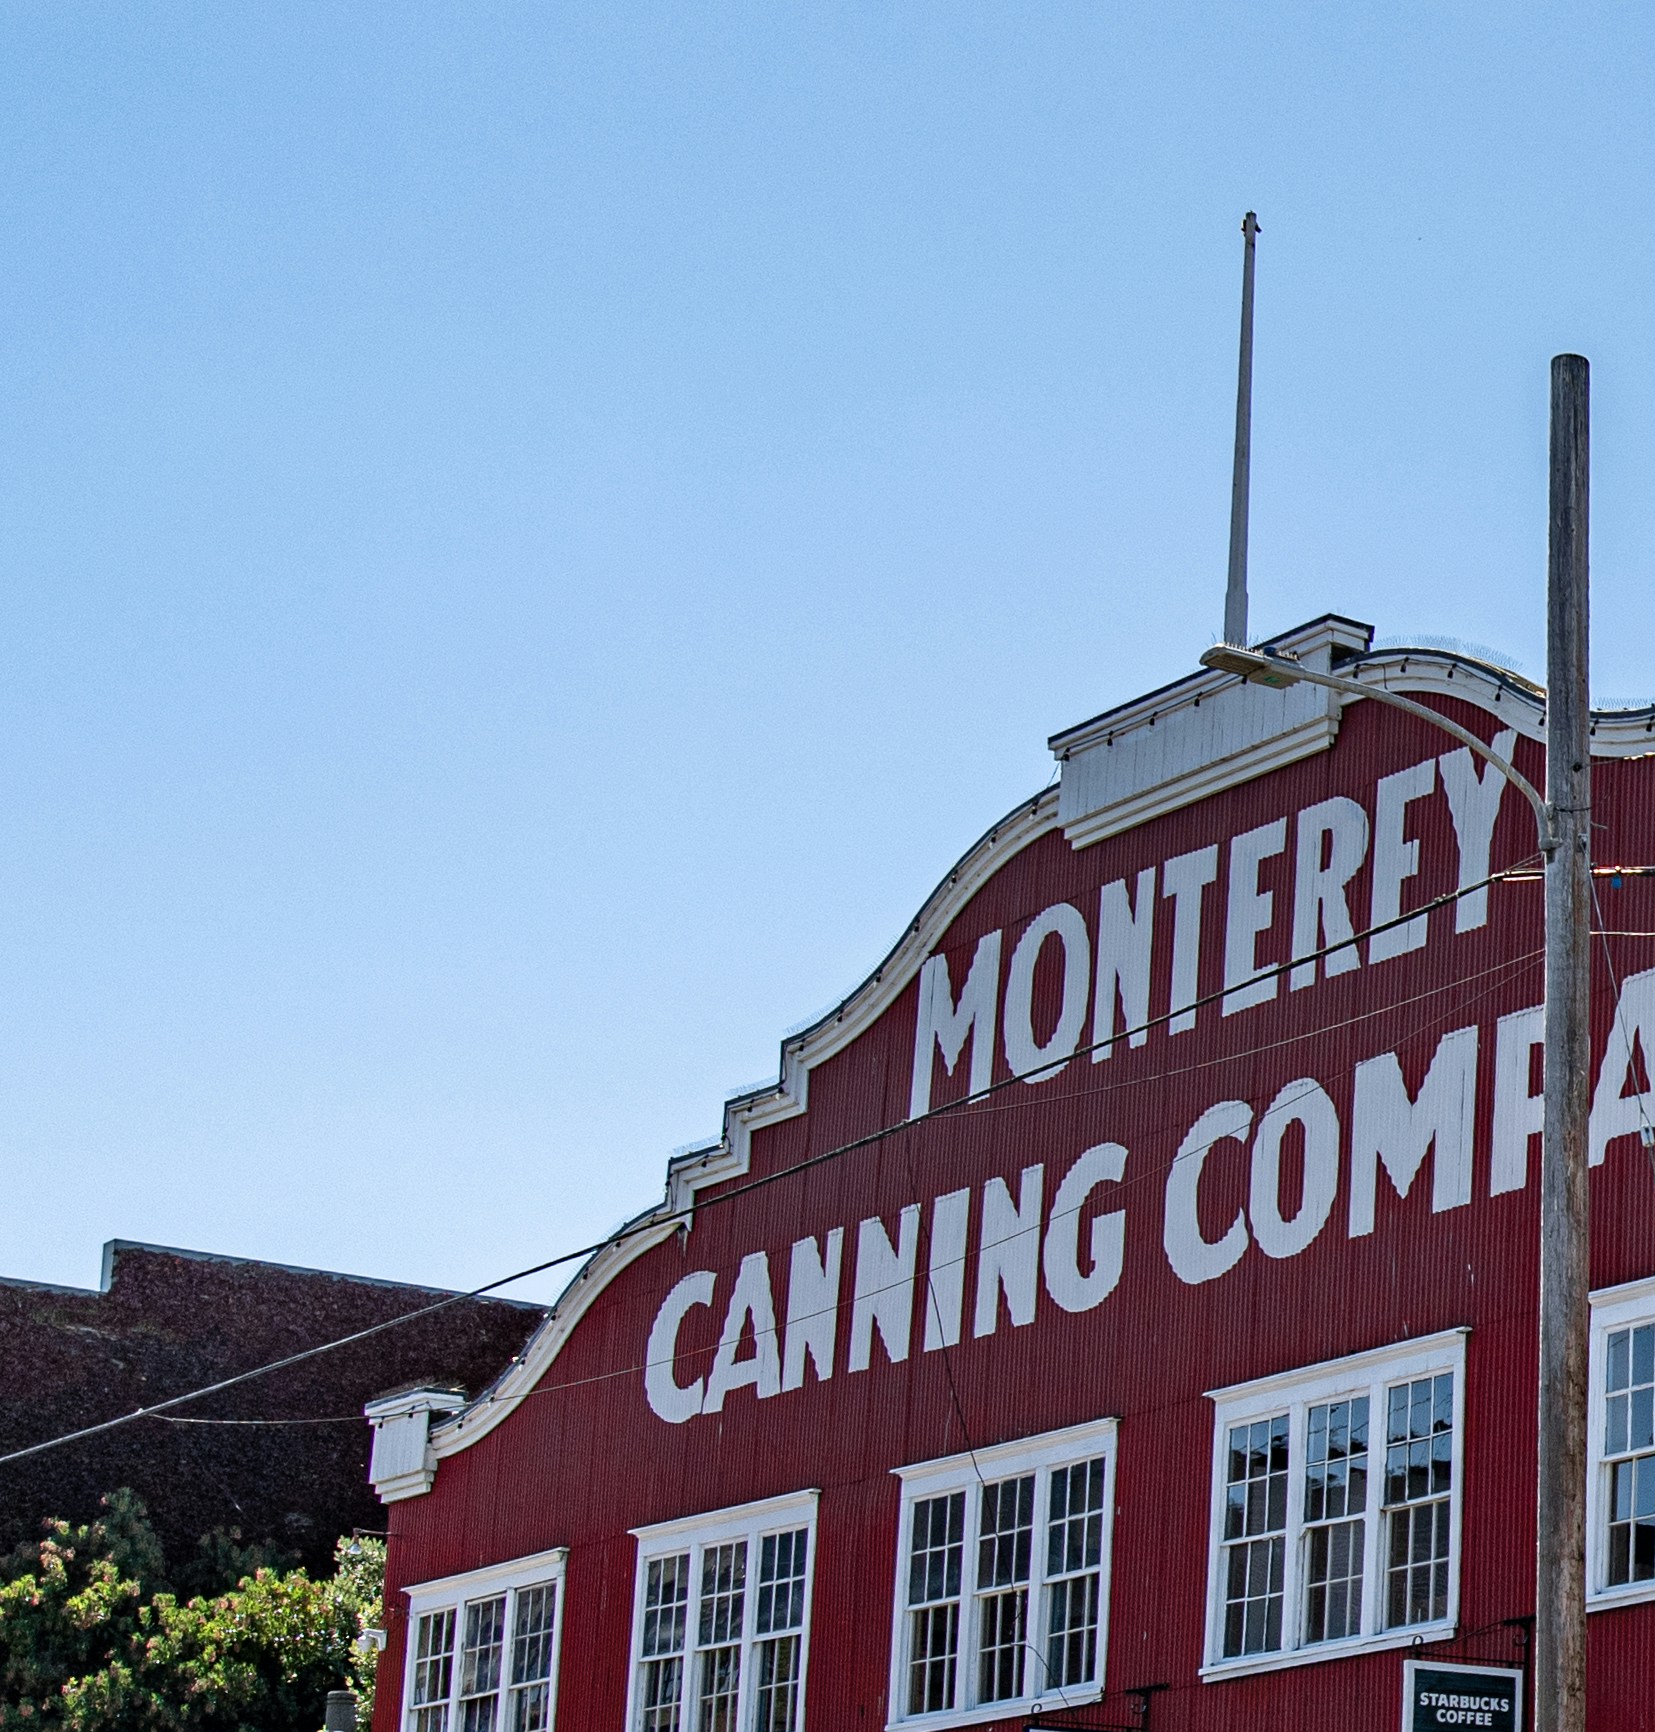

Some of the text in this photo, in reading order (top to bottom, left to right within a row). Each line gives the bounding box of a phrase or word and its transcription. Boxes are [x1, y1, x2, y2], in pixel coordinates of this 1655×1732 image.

[910, 729, 1519, 1121] MONTEREY
[646, 1140, 1130, 1424] CANNING
[1420, 1692, 1509, 1712] STARBUCKS
[1436, 1708, 1493, 1726] COFFEE
